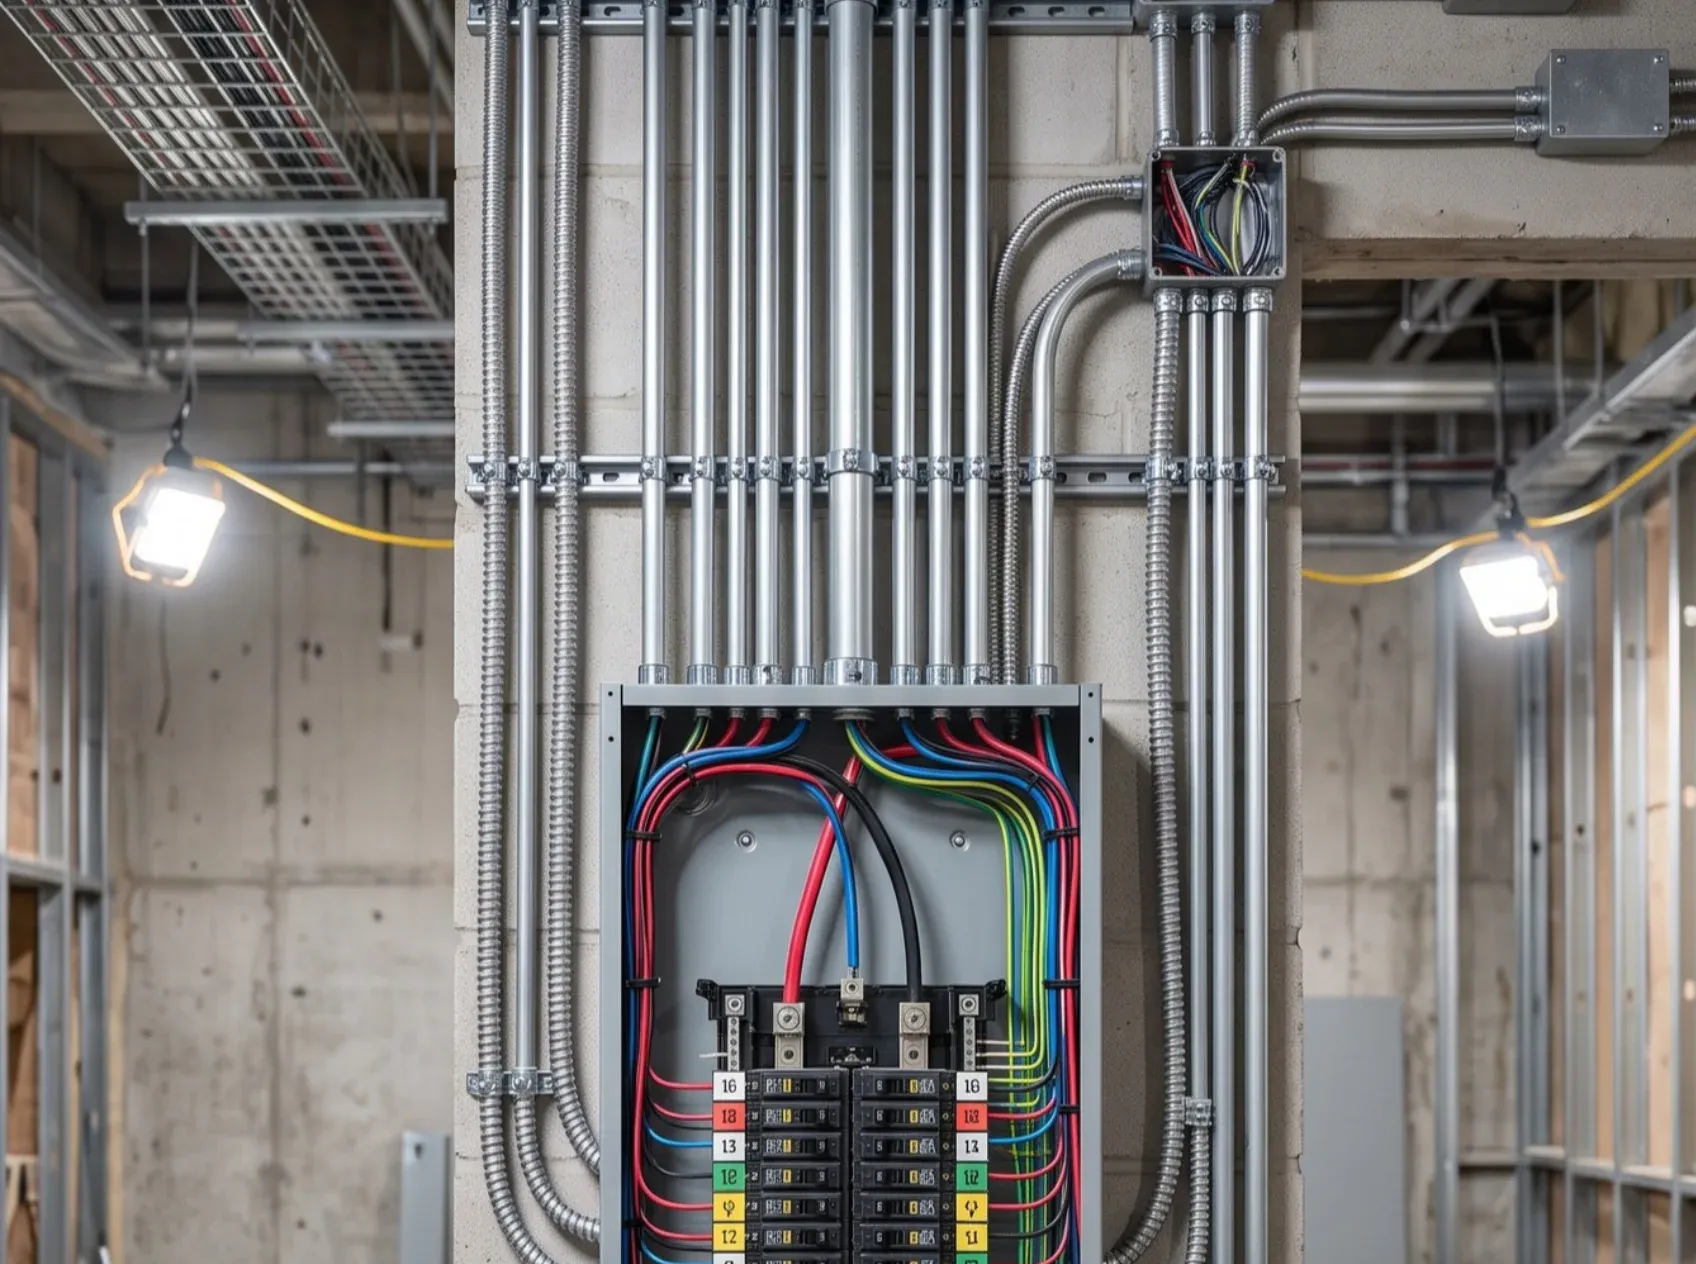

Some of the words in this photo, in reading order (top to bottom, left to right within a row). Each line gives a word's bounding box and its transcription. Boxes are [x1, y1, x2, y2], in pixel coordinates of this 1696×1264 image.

[722, 1078, 737, 1094] 16
[722, 1139, 737, 1154] 13
[721, 1229, 737, 1245] 12
